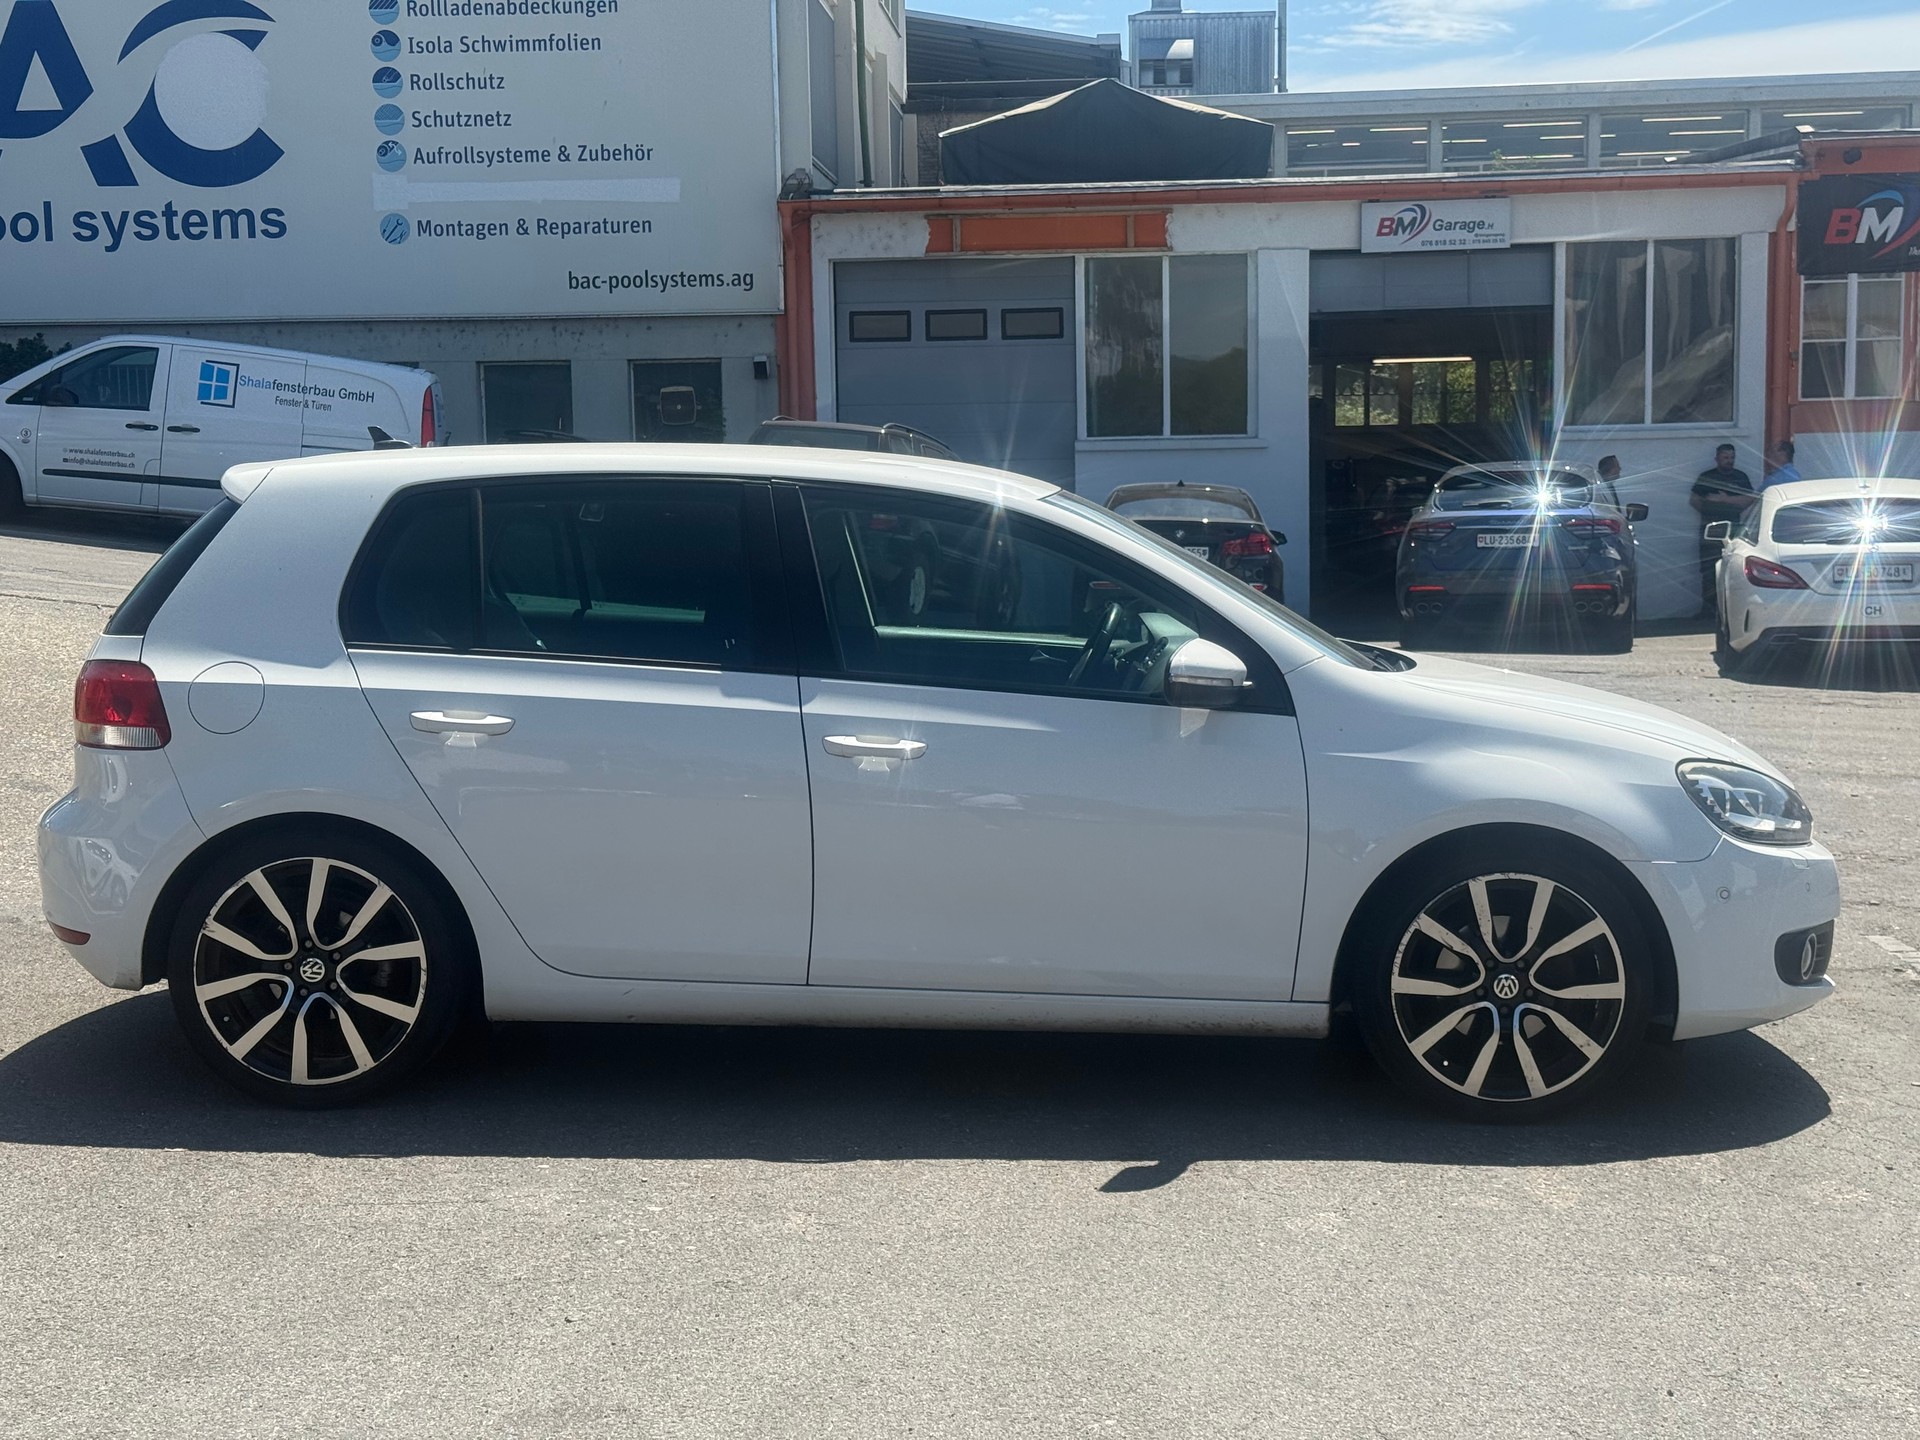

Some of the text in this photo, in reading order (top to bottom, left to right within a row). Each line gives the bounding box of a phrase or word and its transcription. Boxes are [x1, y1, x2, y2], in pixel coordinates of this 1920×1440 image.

[406, 0, 619, 18] Rollladenabdeckungen
[407, 33, 602, 54] Isola Schwimmfolien
[409, 72, 506, 91] Rollschutz
[411, 110, 513, 128] Schutznetz
[413, 144, 654, 168] Aufrollsysteme & Zubehör
[0, 201, 288, 253] ol systems
[416, 217, 652, 240] Montagen & Reparaturen
[1376, 216, 1417, 237] BM
[568, 270, 754, 293] bac-poolsystems.ag
[239, 375, 375, 403] Shalafensterbau GmbH
[274, 396, 302, 407] Fenster
[303, 400, 310, 409] &
[1865, 606, 1882, 615] CH
